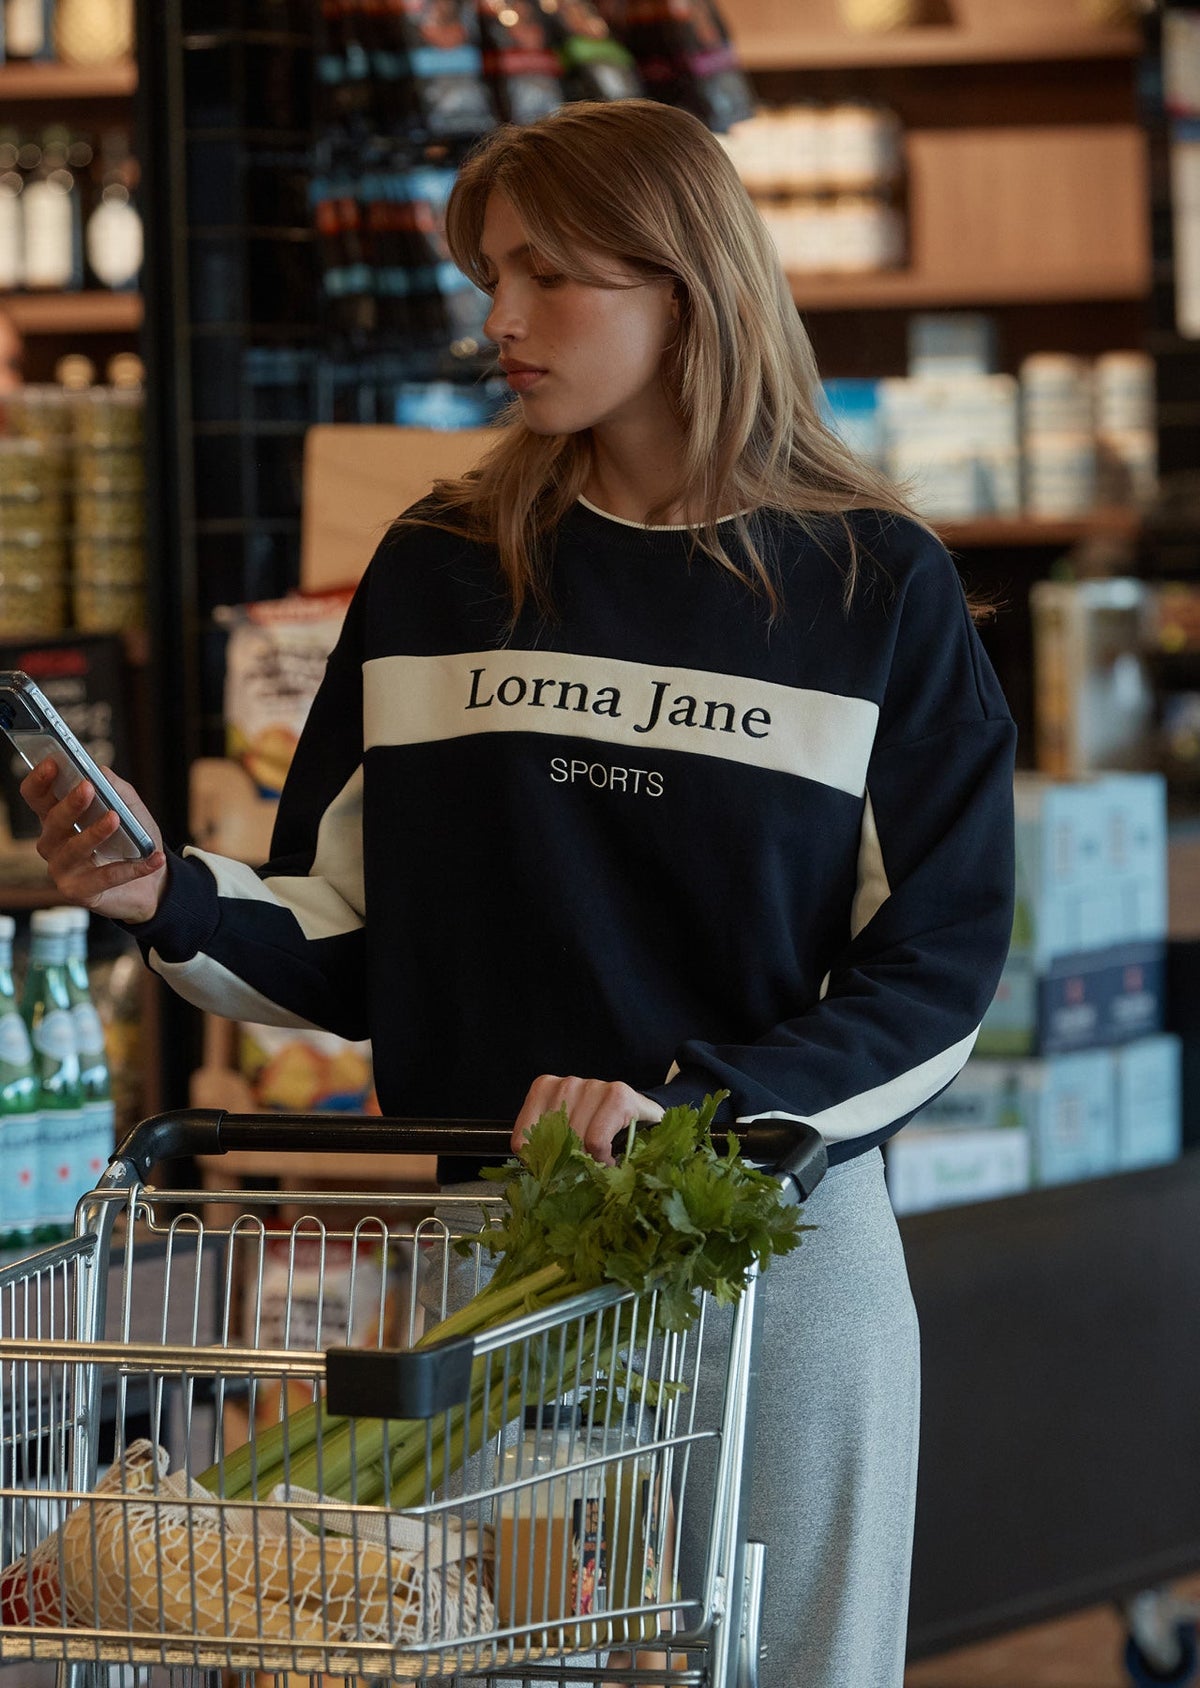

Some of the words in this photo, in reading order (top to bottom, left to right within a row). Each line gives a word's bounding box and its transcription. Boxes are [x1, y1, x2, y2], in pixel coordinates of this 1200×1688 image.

[464, 667, 622, 718] Lorna
[632, 680, 772, 739] Jane
[550, 757, 664, 797] SPORTS
